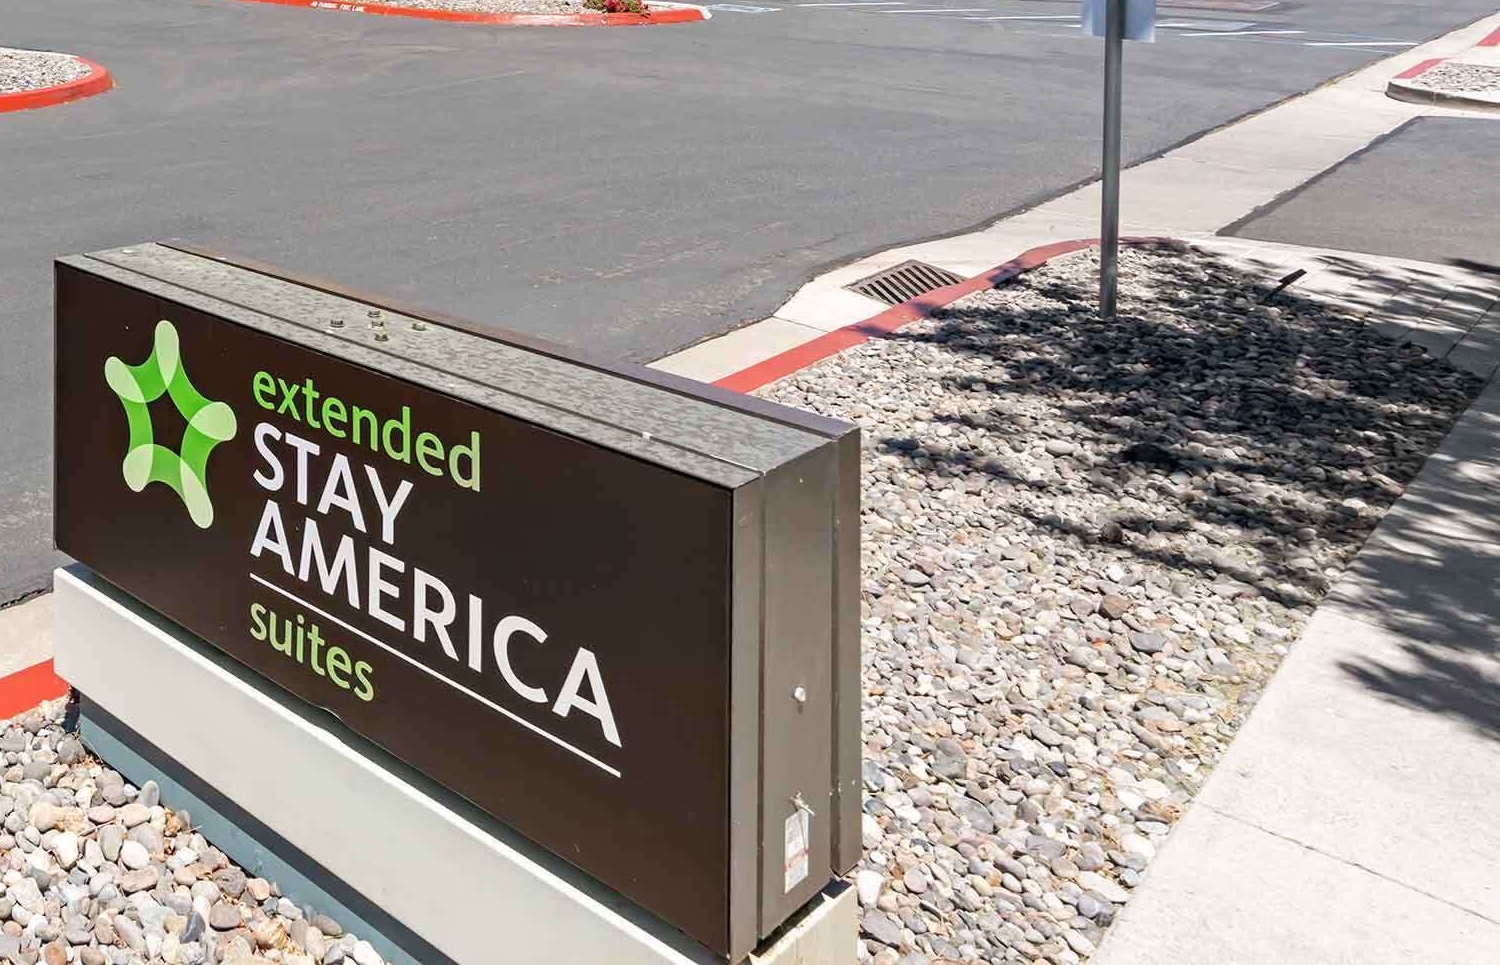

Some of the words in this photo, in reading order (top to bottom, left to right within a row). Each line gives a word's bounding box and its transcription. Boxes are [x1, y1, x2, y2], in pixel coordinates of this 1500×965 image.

[252, 370, 481, 492] extended
[252, 422, 414, 545] STAY
[250, 499, 622, 748] AMERICA
[250, 602, 375, 702] suites
